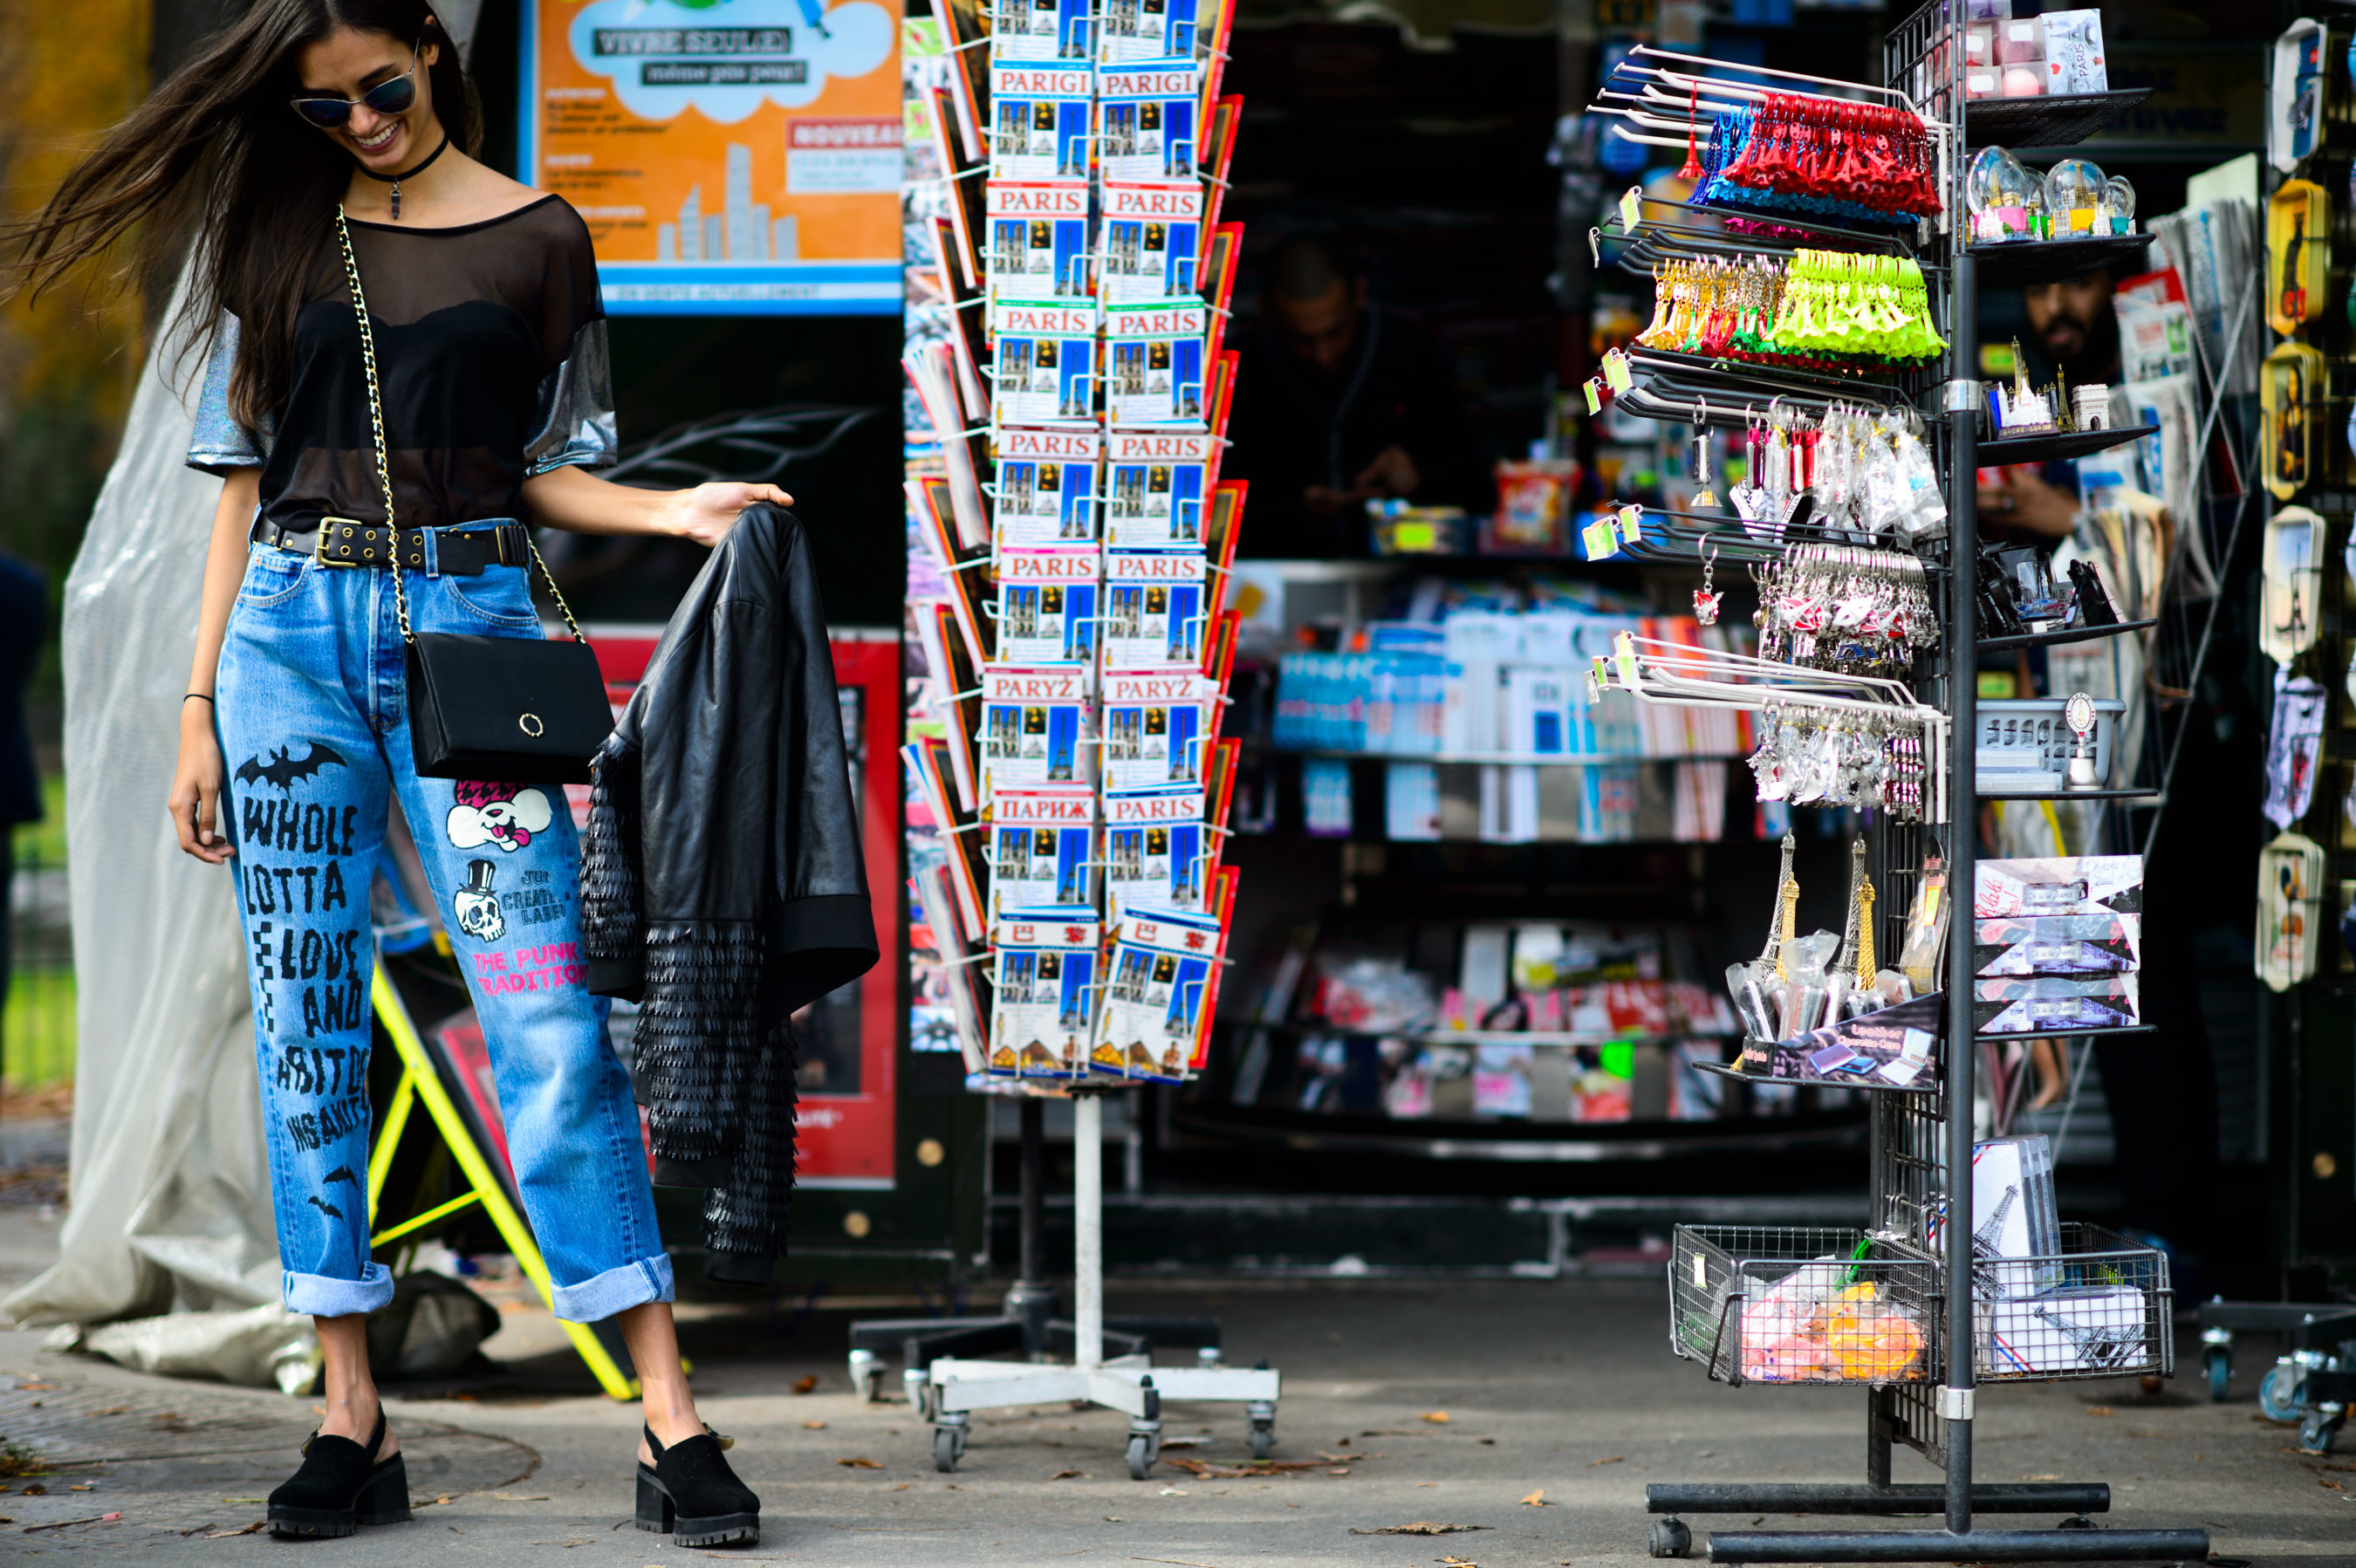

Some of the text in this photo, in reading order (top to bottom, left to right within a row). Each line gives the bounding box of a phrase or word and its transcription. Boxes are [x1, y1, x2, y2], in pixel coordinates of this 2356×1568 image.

[599, 30, 791, 54] VIVRE SEUL(E)
[2074, 43, 2090, 78] PARIS
[1000, 72, 1087, 92] PARIGI
[1106, 73, 1192, 94] PARIGI
[999, 191, 1080, 210] PARIS
[1116, 192, 1195, 214] PARIS
[1007, 308, 1087, 332] PARÍS
[1119, 309, 1196, 333] PARÍS
[1009, 435, 1090, 455] PARIS
[1121, 438, 1201, 456] PARIS
[1784, 496, 1799, 520] PARIS
[1011, 558, 1091, 576] PARIS
[1117, 558, 1196, 577] PARIS
[995, 674, 1074, 697] PARYŻ
[1116, 675, 1193, 698] PARYŻ
[1002, 800, 1088, 818] ПАРИЖ
[1115, 798, 1195, 820] PARIS
[243, 796, 358, 857] WHOLE
[243, 859, 346, 914] LOTTA
[2052, 889, 2073, 901] Paris
[280, 928, 360, 982] LOVE
[473, 941, 579, 974] THE PUNK
[2055, 946, 2076, 958] Paris
[303, 978, 363, 1038] AND
[2055, 1003, 2076, 1015] Paris
[1852, 1024, 1903, 1039] Leather
[1837, 1035, 1901, 1051] Cigarette Case
[285, 1045, 346, 1095] BIT
